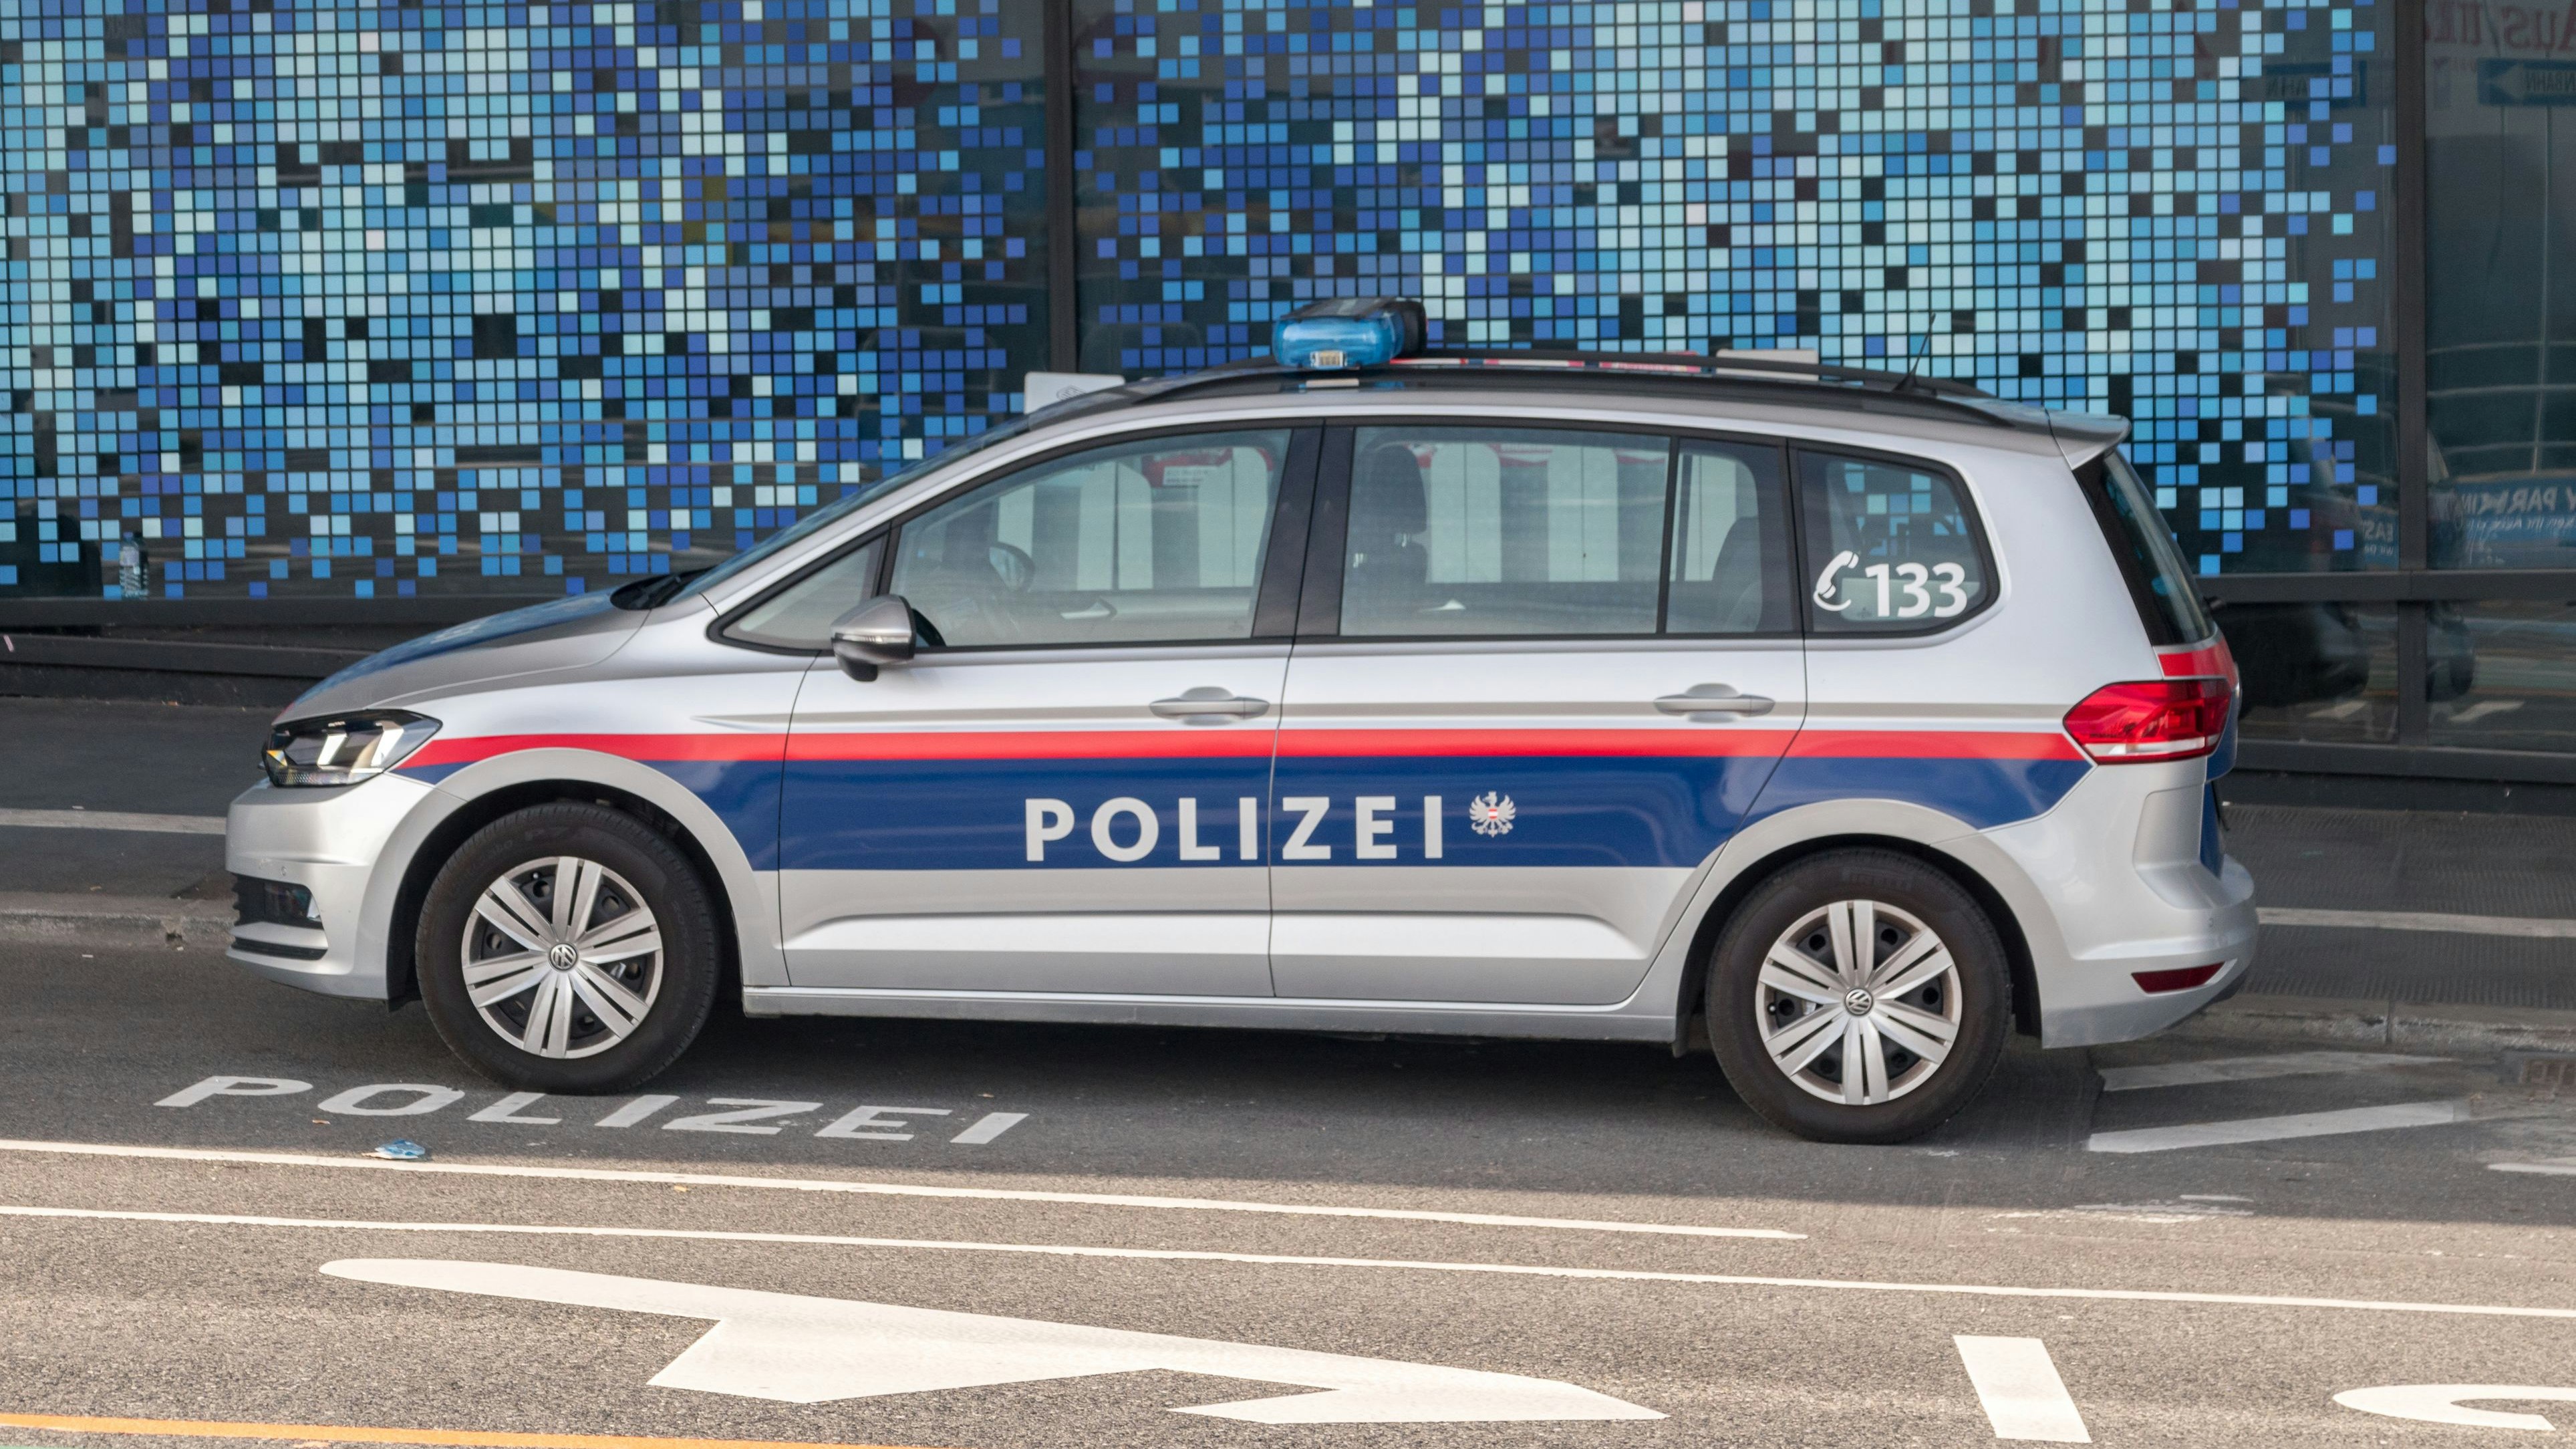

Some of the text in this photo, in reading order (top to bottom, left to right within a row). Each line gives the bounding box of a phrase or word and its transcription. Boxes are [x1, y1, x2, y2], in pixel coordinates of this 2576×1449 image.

[1864, 562, 1967, 618] 133
[1026, 795, 1442, 862] POLIZEI
[153, 1075, 1030, 1144] POLIZEI
